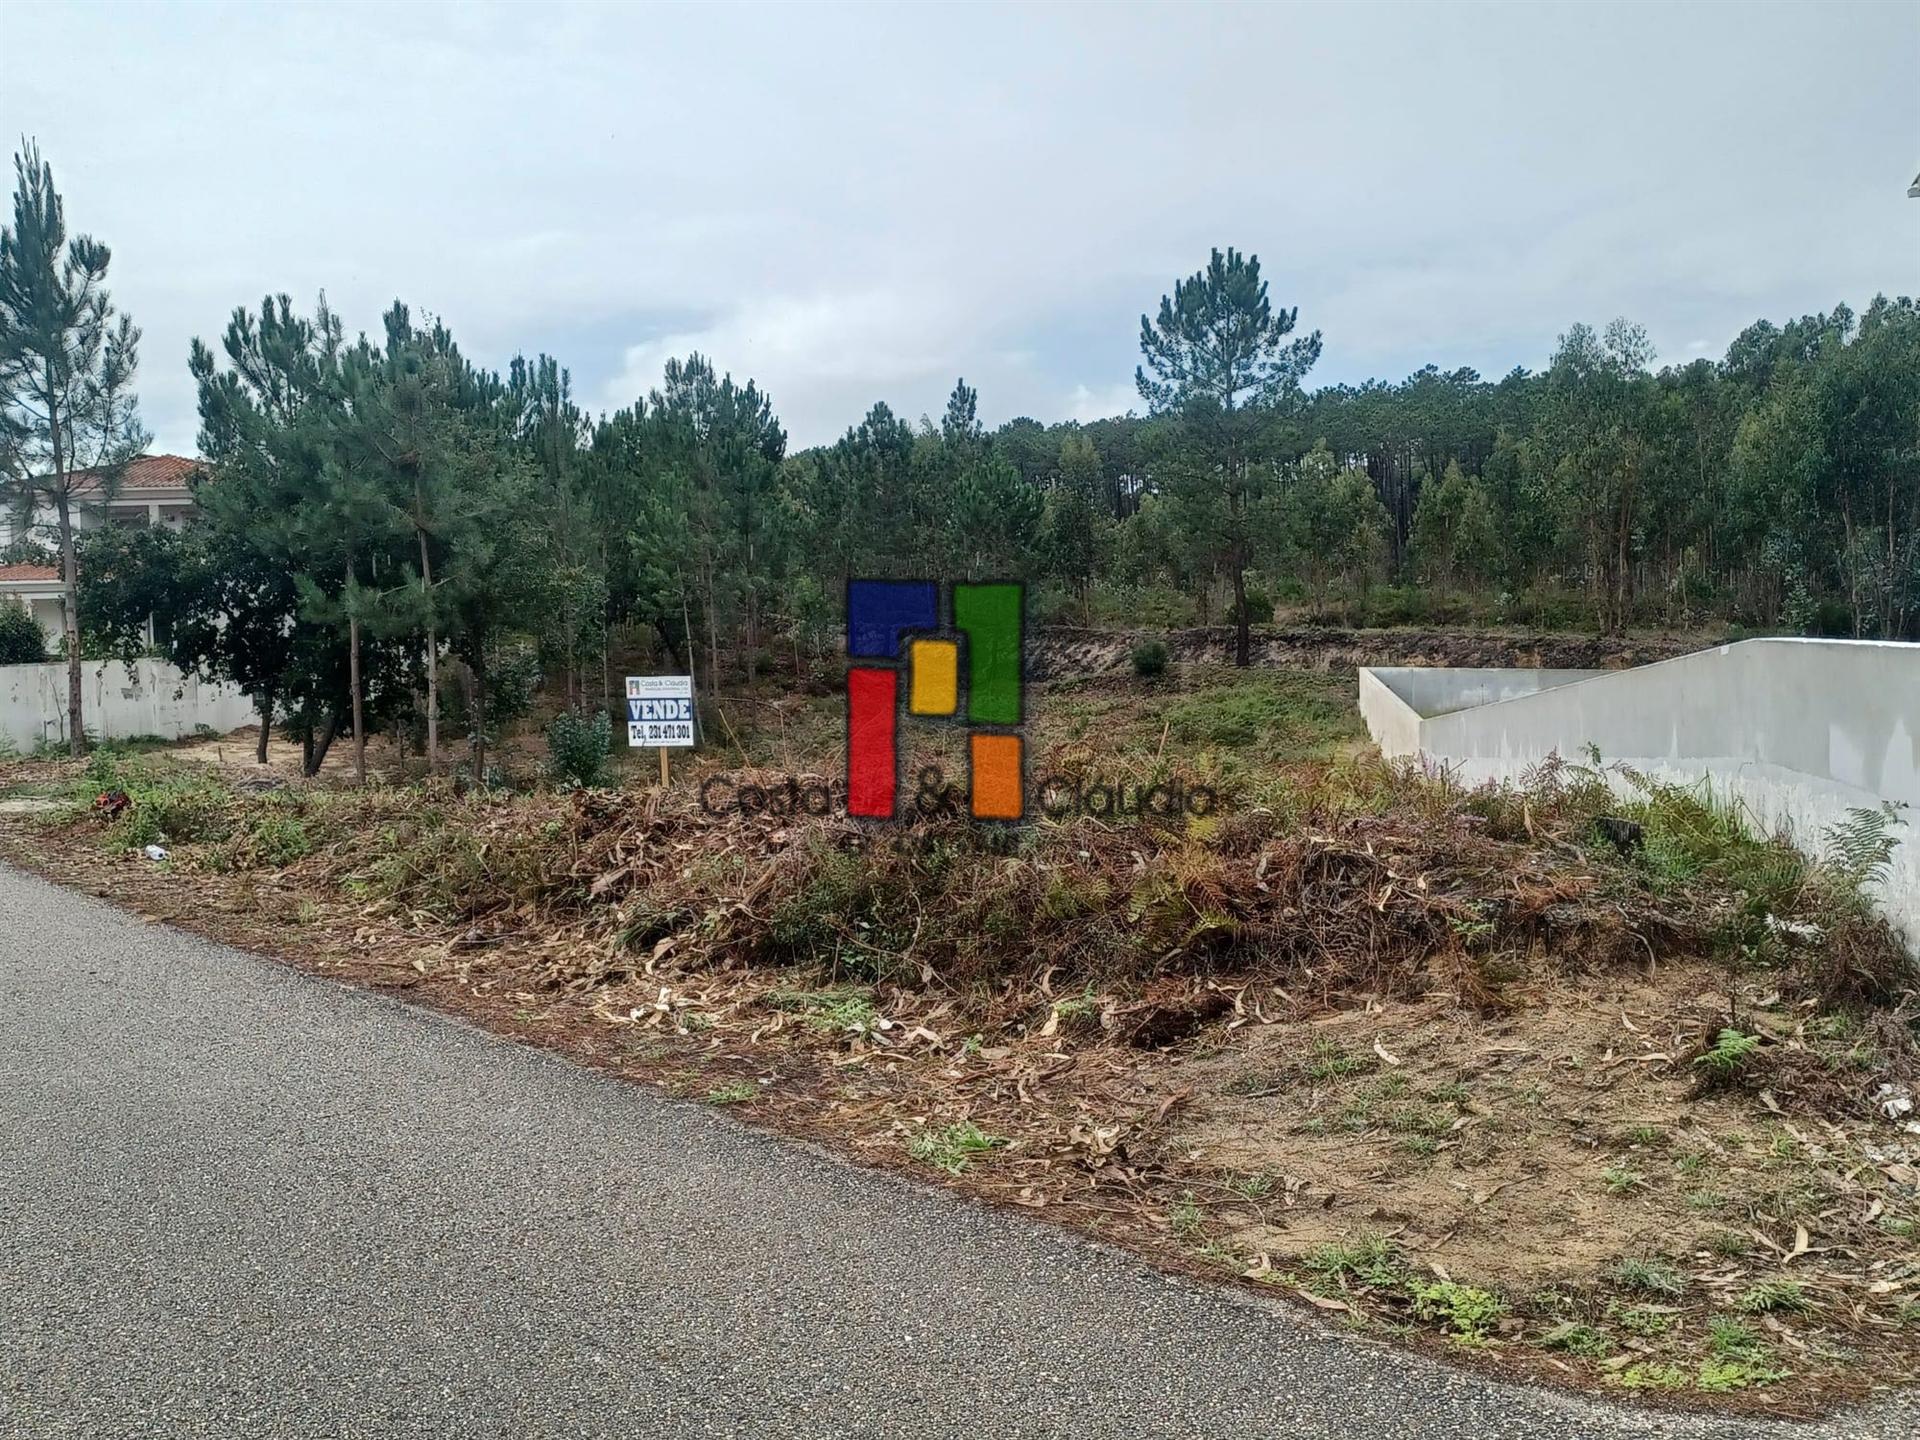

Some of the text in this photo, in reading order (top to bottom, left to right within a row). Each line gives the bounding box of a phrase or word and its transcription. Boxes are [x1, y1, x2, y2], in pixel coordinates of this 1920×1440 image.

[629, 699, 690, 720] VENDE
[649, 725, 661, 739] 231
[663, 724, 675, 739] 471
[676, 724, 690, 739] 301
